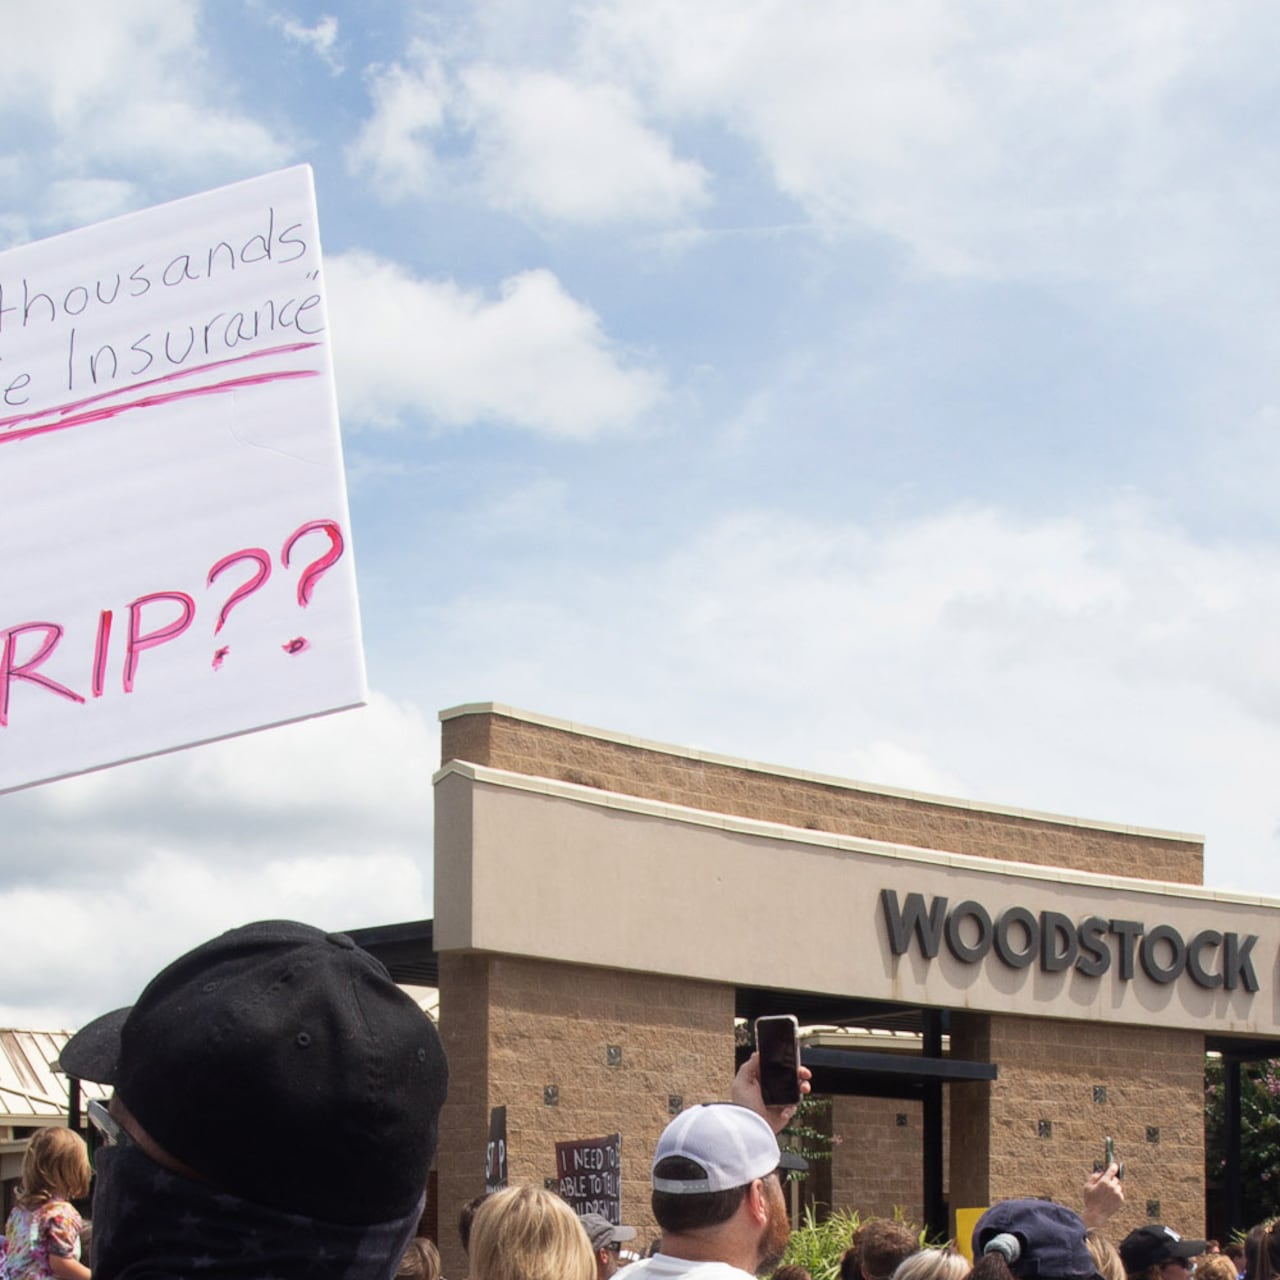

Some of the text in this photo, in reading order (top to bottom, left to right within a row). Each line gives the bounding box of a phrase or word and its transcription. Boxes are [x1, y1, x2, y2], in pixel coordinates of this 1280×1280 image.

[881, 888, 1260, 993] WOODSTOCK
[561, 1149, 567, 1172] I
[573, 1147, 604, 1171] NEED
[606, 1145, 615, 1168] TO
[560, 1175, 587, 1198] ABLE
[588, 1174, 601, 1194] TO
